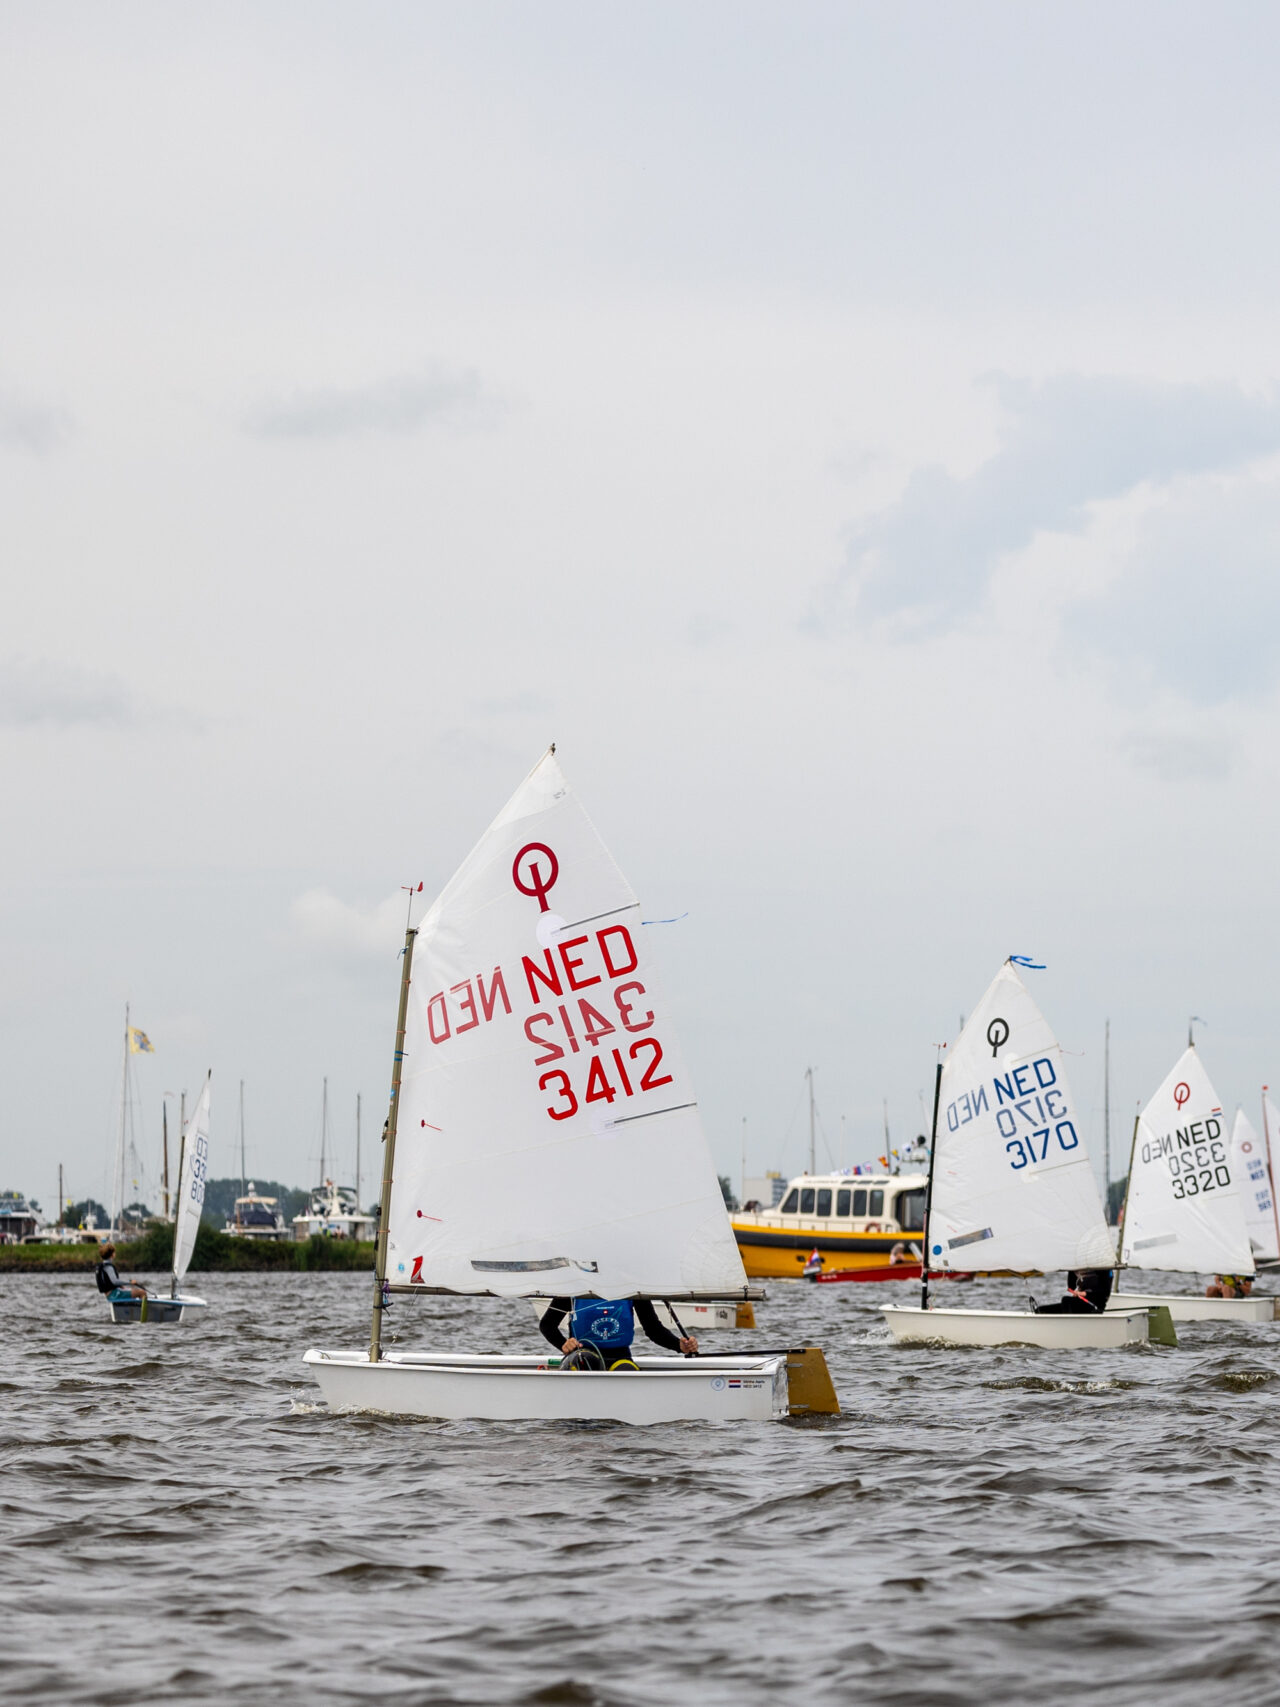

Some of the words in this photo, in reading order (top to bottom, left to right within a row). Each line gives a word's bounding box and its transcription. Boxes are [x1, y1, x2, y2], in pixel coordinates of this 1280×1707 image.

[521, 924, 638, 1004] NED
[538, 1037, 673, 1121] 3412
[993, 1058, 1056, 1105] NED
[1006, 1120, 1078, 1169] 3170
[1176, 1118, 1221, 1149] NED
[1172, 1165, 1231, 1199] 3320
